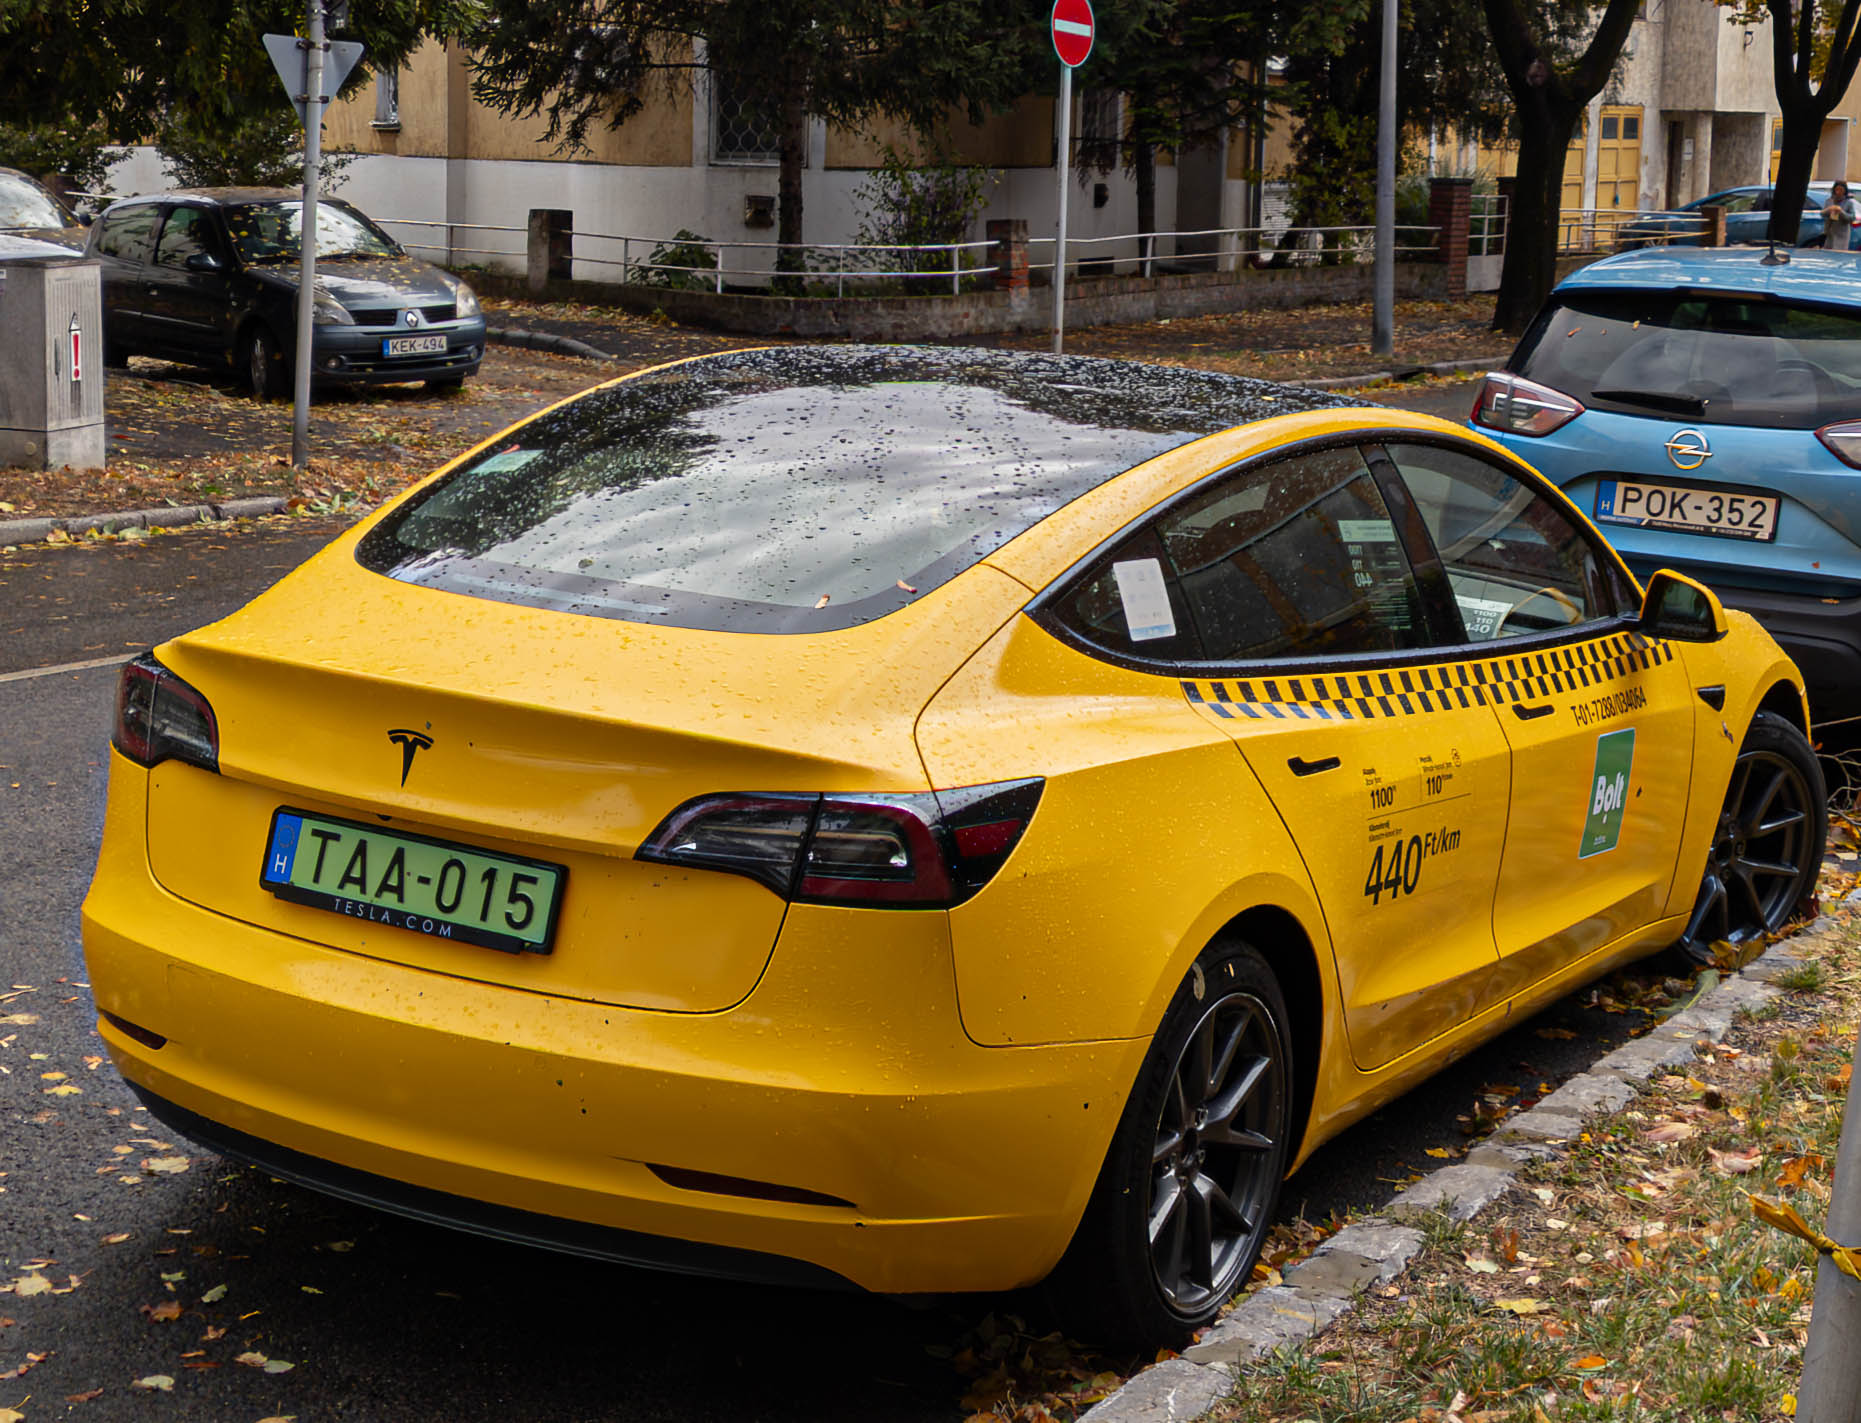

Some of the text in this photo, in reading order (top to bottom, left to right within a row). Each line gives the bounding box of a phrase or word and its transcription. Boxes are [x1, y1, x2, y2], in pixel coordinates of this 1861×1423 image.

[391, 337, 444, 353] KEK-494
[1601, 500, 1610, 511] H
[1621, 486, 1767, 529] POK-352
[1592, 771, 1625, 816] Bolt
[274, 828, 539, 931] H TAA-015
[334, 898, 452, 937] TESLA.COM
